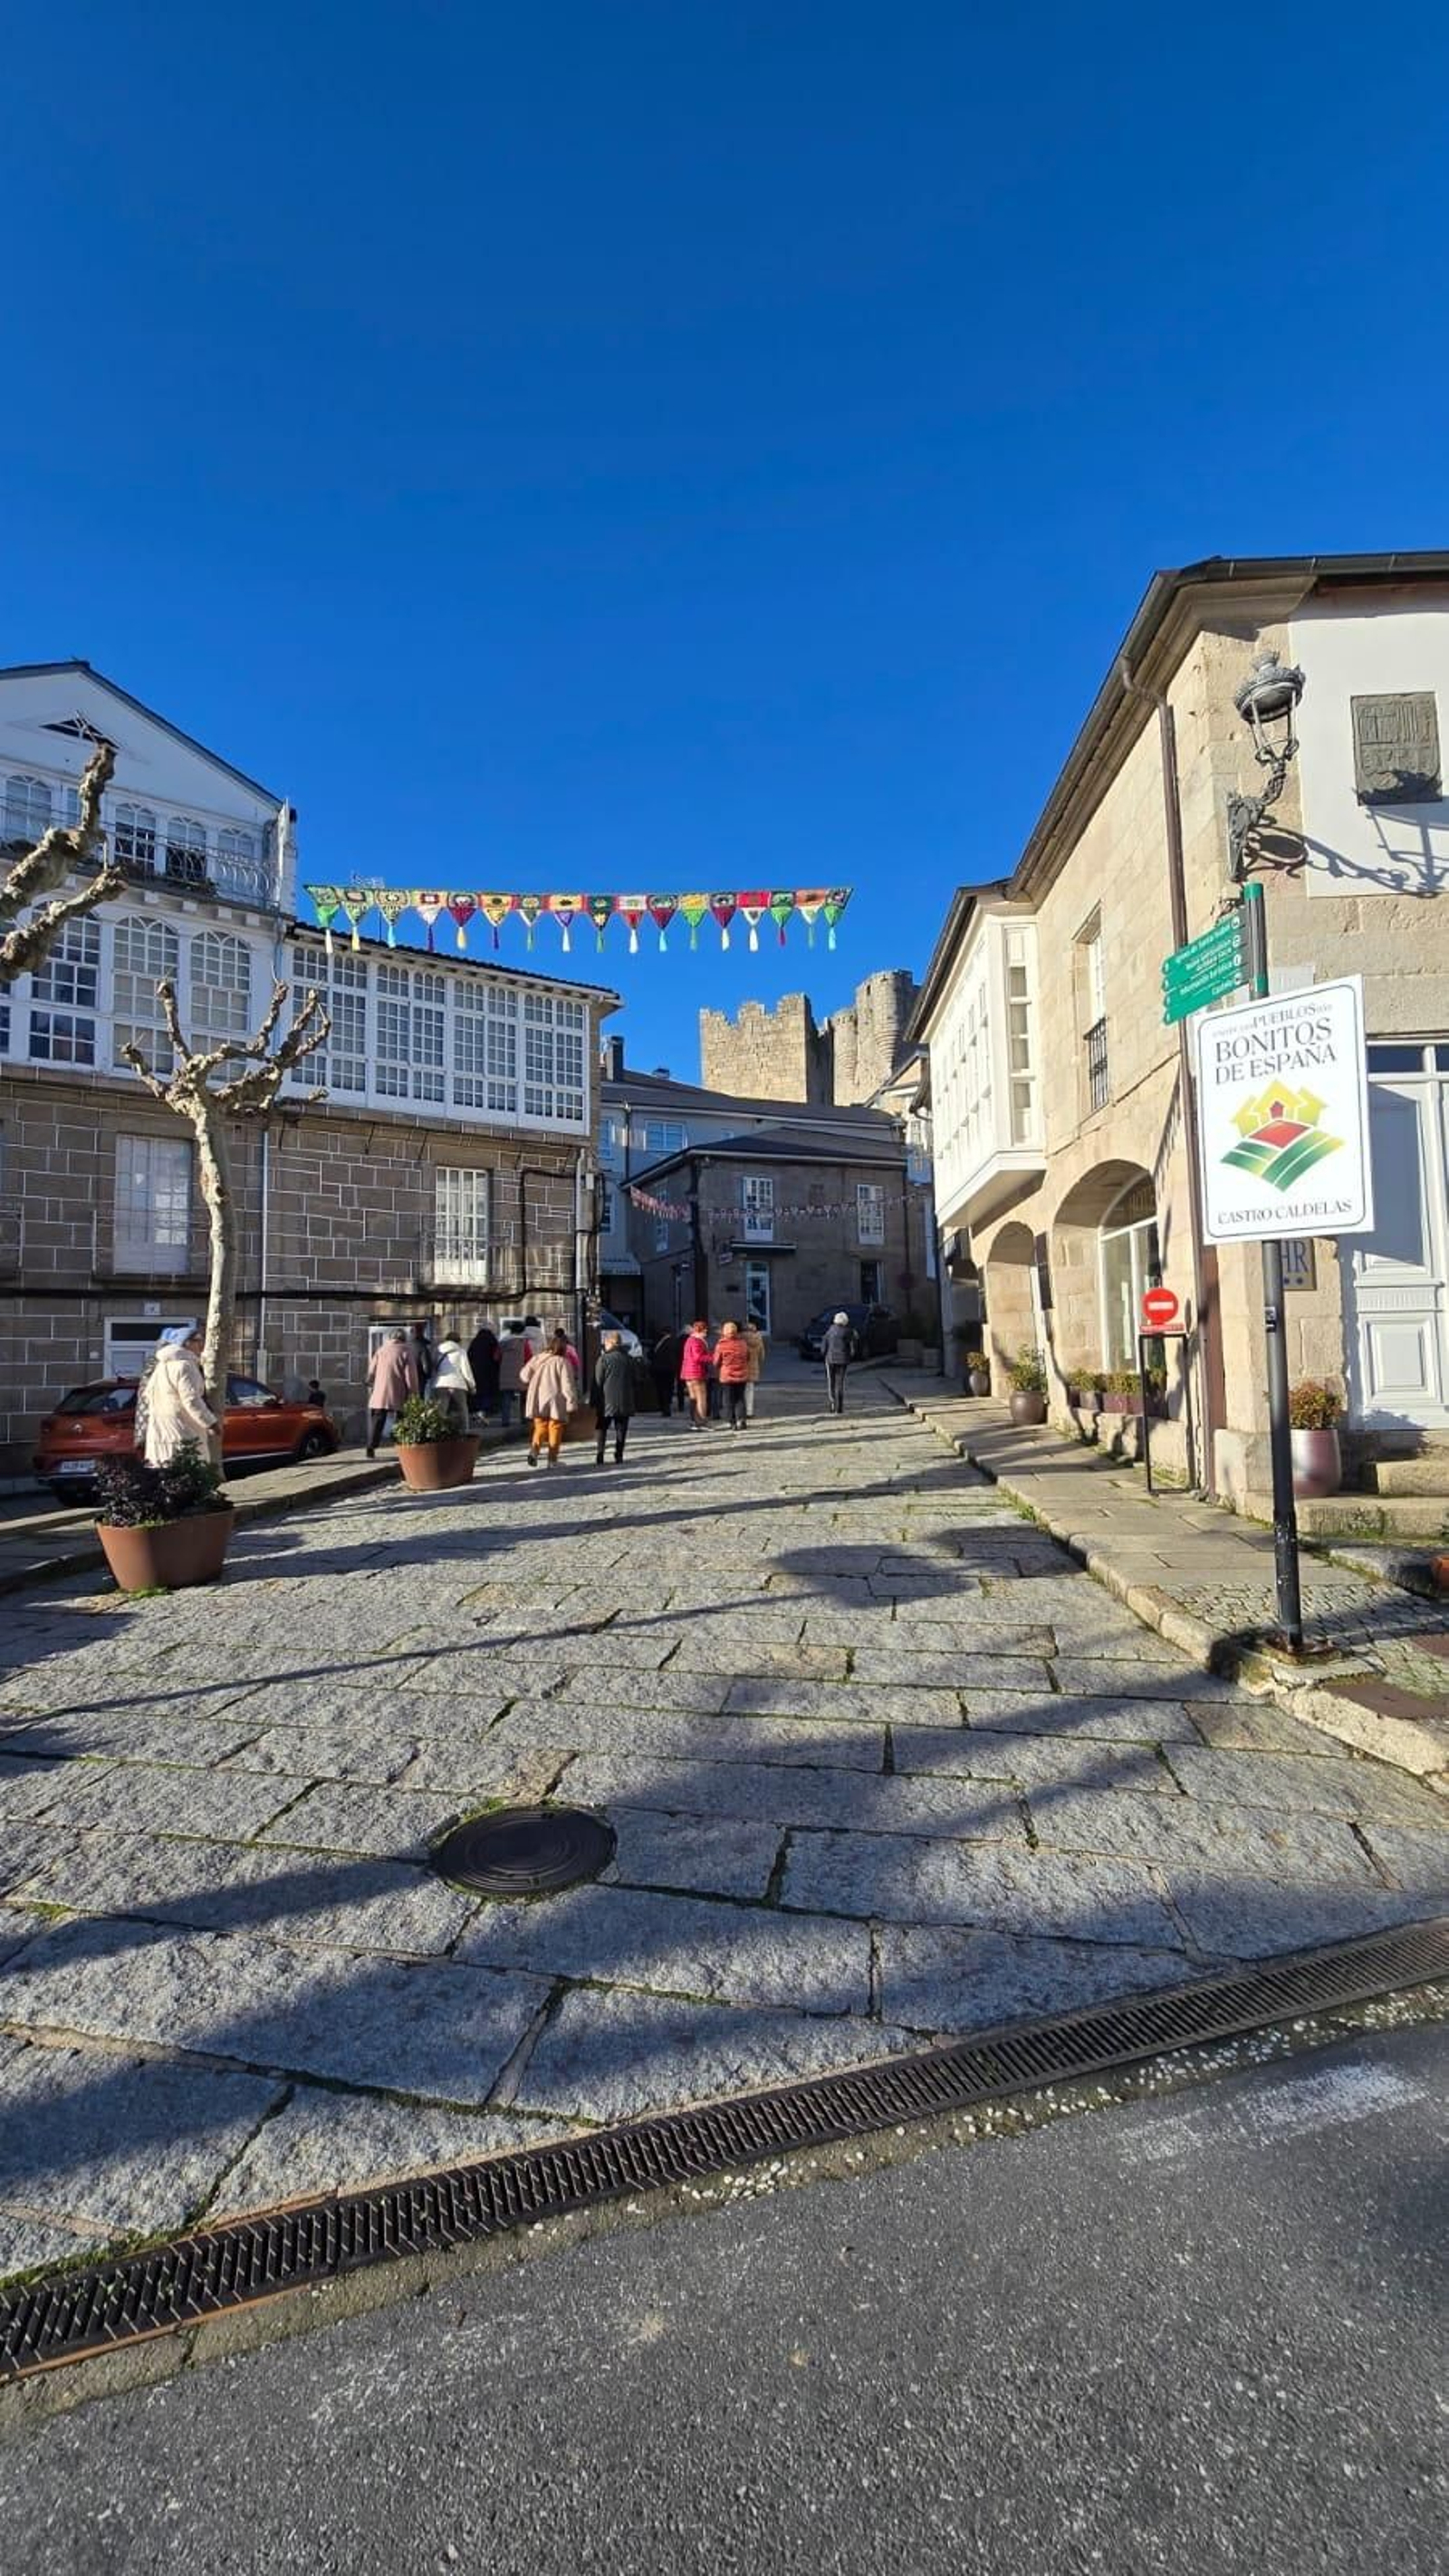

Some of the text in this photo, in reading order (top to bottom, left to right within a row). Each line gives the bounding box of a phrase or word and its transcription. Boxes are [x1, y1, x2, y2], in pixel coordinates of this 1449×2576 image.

[1253, 1003, 1316, 1029] PUEBLOS
[1216, 1017, 1332, 1063] BONITOS
[1216, 1043, 1336, 1085] DE ESPAÑA
[1218, 1199, 1352, 1224] CASTRO CALDELAS
